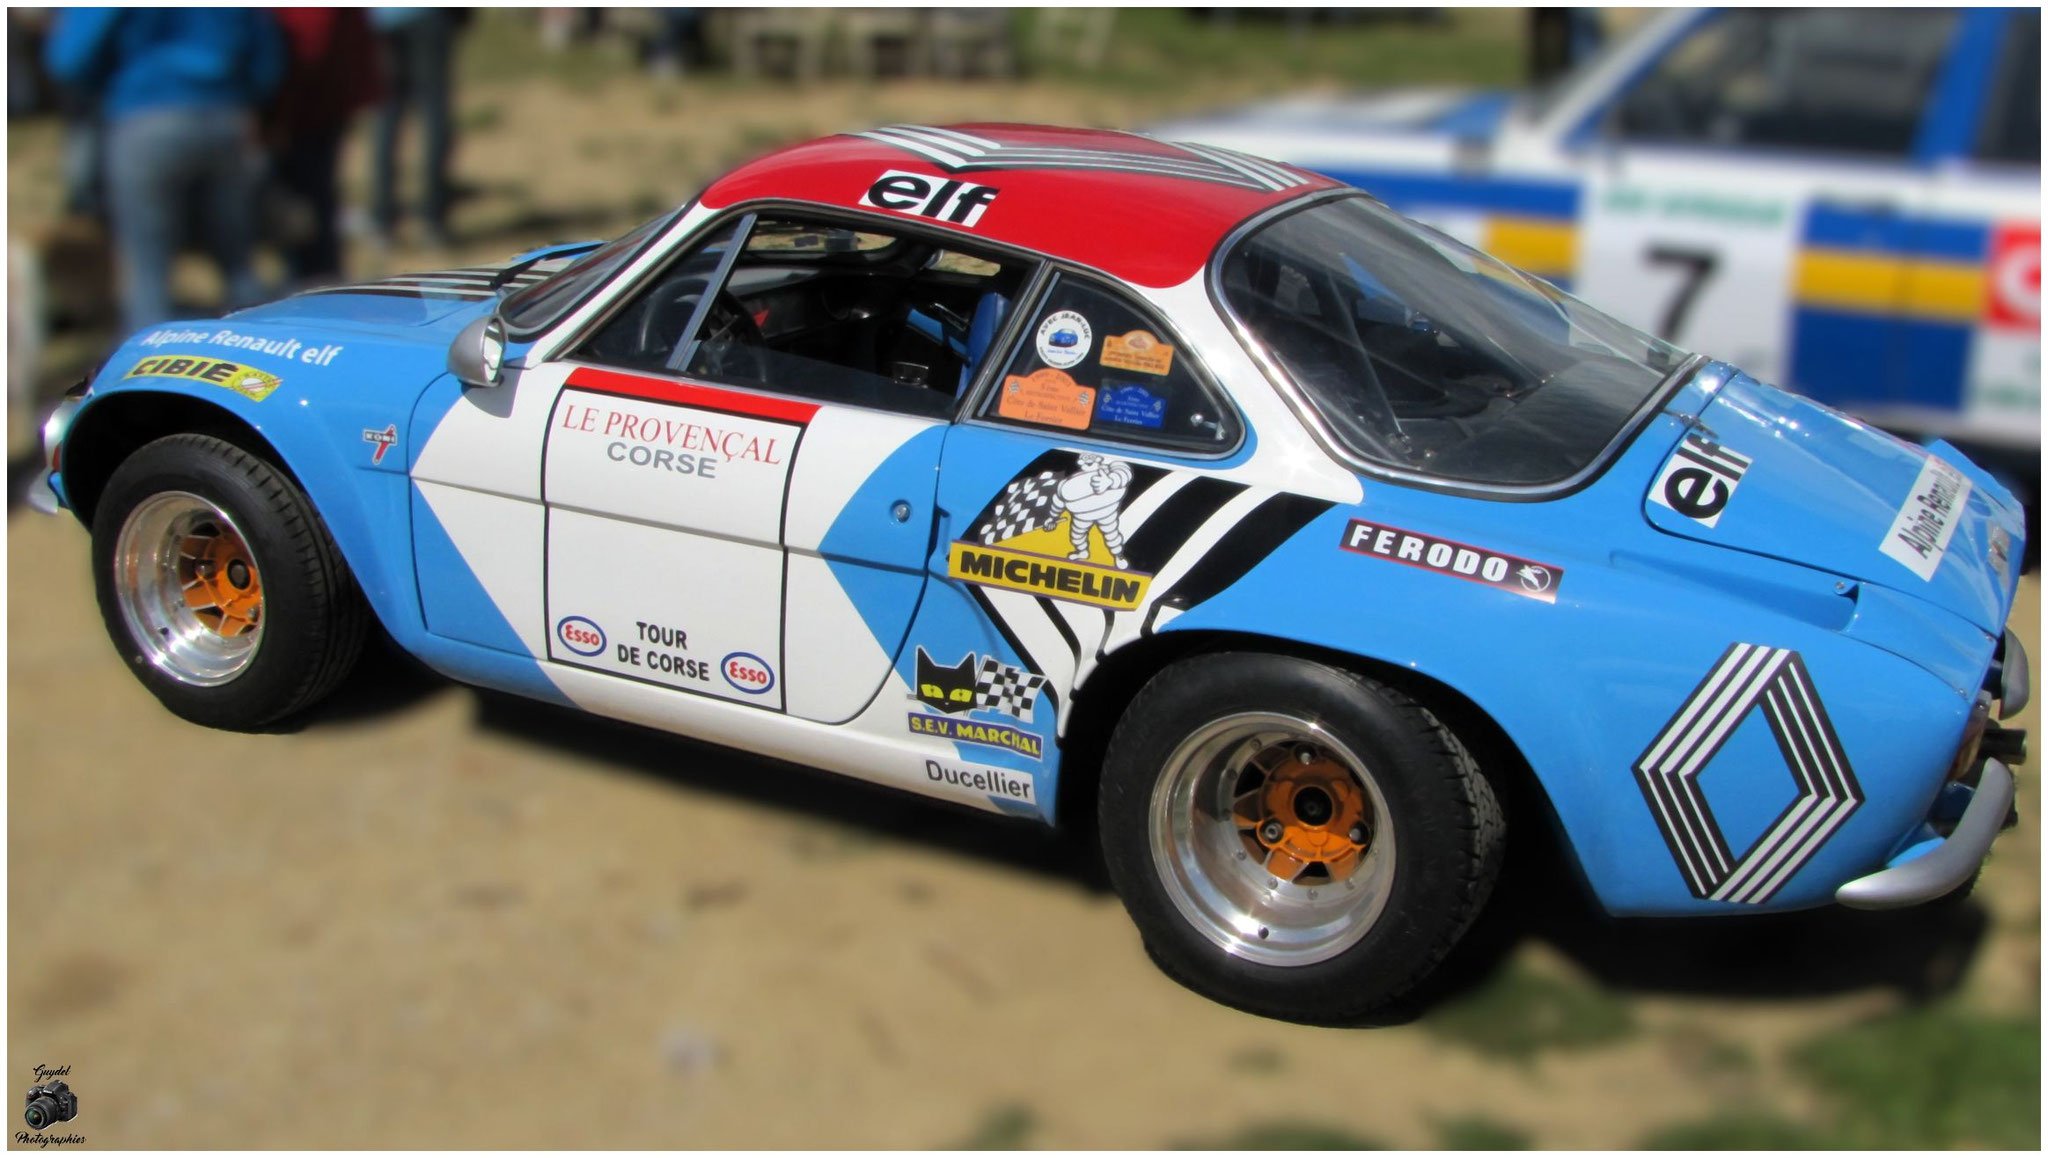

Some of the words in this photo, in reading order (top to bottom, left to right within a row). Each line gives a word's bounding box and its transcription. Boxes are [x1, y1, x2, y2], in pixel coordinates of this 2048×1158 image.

[868, 175, 1000, 224] elf
[1642, 244, 1719, 362] 7
[1040, 315, 1058, 335] AVEC
[141, 330, 209, 348] Alpine
[207, 330, 303, 360] Renault
[300, 344, 343, 366] elf
[561, 404, 600, 433] LE
[603, 411, 782, 465] PROVENÇAL
[607, 441, 718, 479] CORSE
[1665, 433, 1749, 519] elf
[1350, 525, 1508, 582] FERODO
[1898, 508, 1944, 560] Alpine
[960, 550, 1140, 603] MICHELIN
[565, 624, 600, 647] Esso
[636, 621, 688, 650] TOUR
[617, 644, 641, 666] DE
[647, 650, 710, 682] CORSE
[729, 661, 767, 685] Esso
[911, 716, 952, 736] S.E.V.
[956, 722, 1040, 756] MARCHAL
[926, 760, 1030, 798] Ducellier
